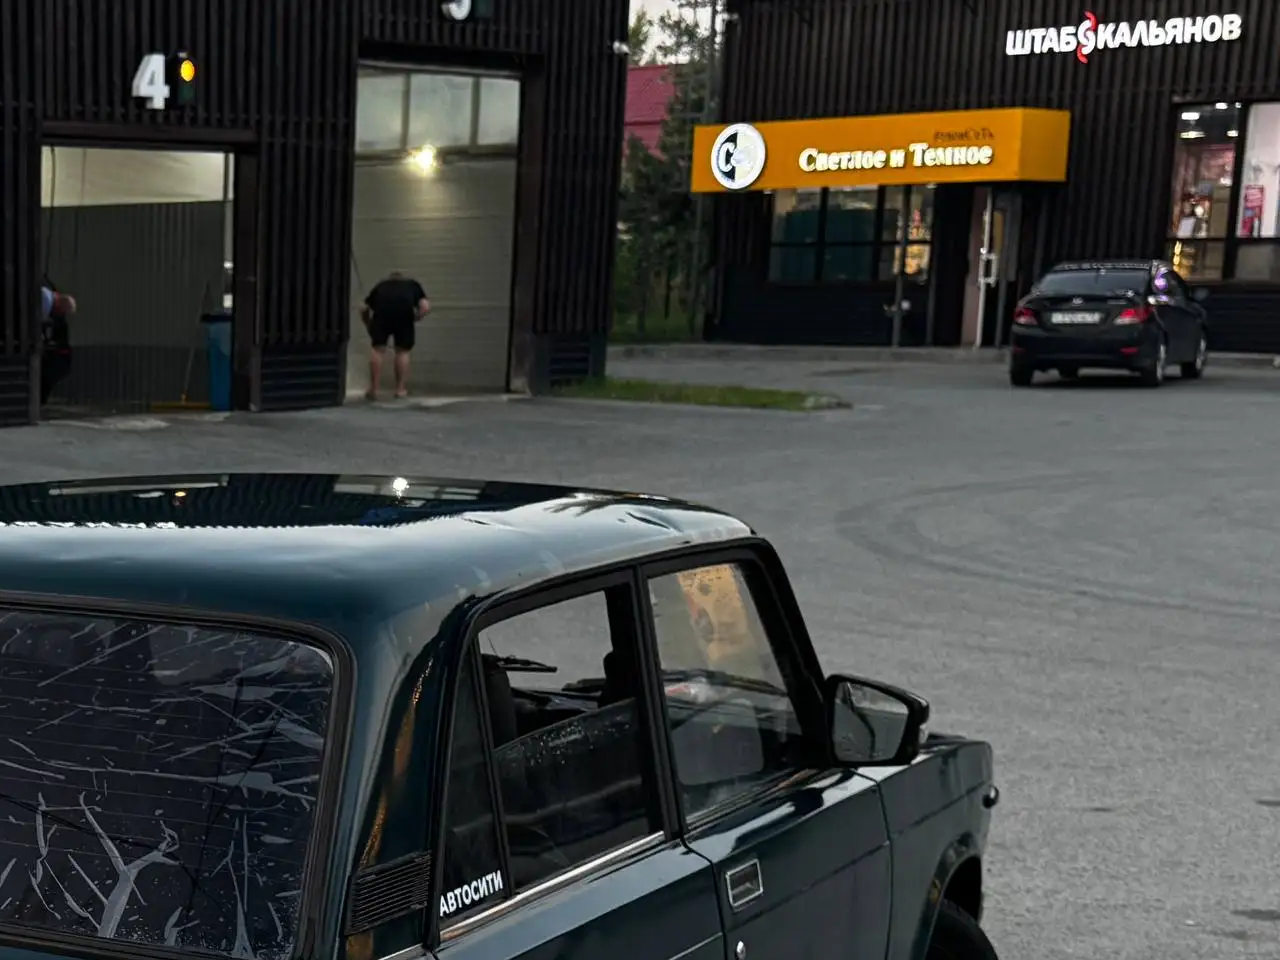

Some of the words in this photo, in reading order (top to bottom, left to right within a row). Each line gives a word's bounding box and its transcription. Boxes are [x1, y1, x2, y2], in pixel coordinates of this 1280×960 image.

[1006, 26, 1077, 55] ШТАБ
[1096, 14, 1242, 49] КАЛЬЯНОВ
[131, 53, 170, 110] 4
[799, 147, 887, 172] Светлое
[889, 149, 906, 168] и
[909, 142, 993, 167] Темное
[440, 869, 504, 917] АВТОСИТИ
